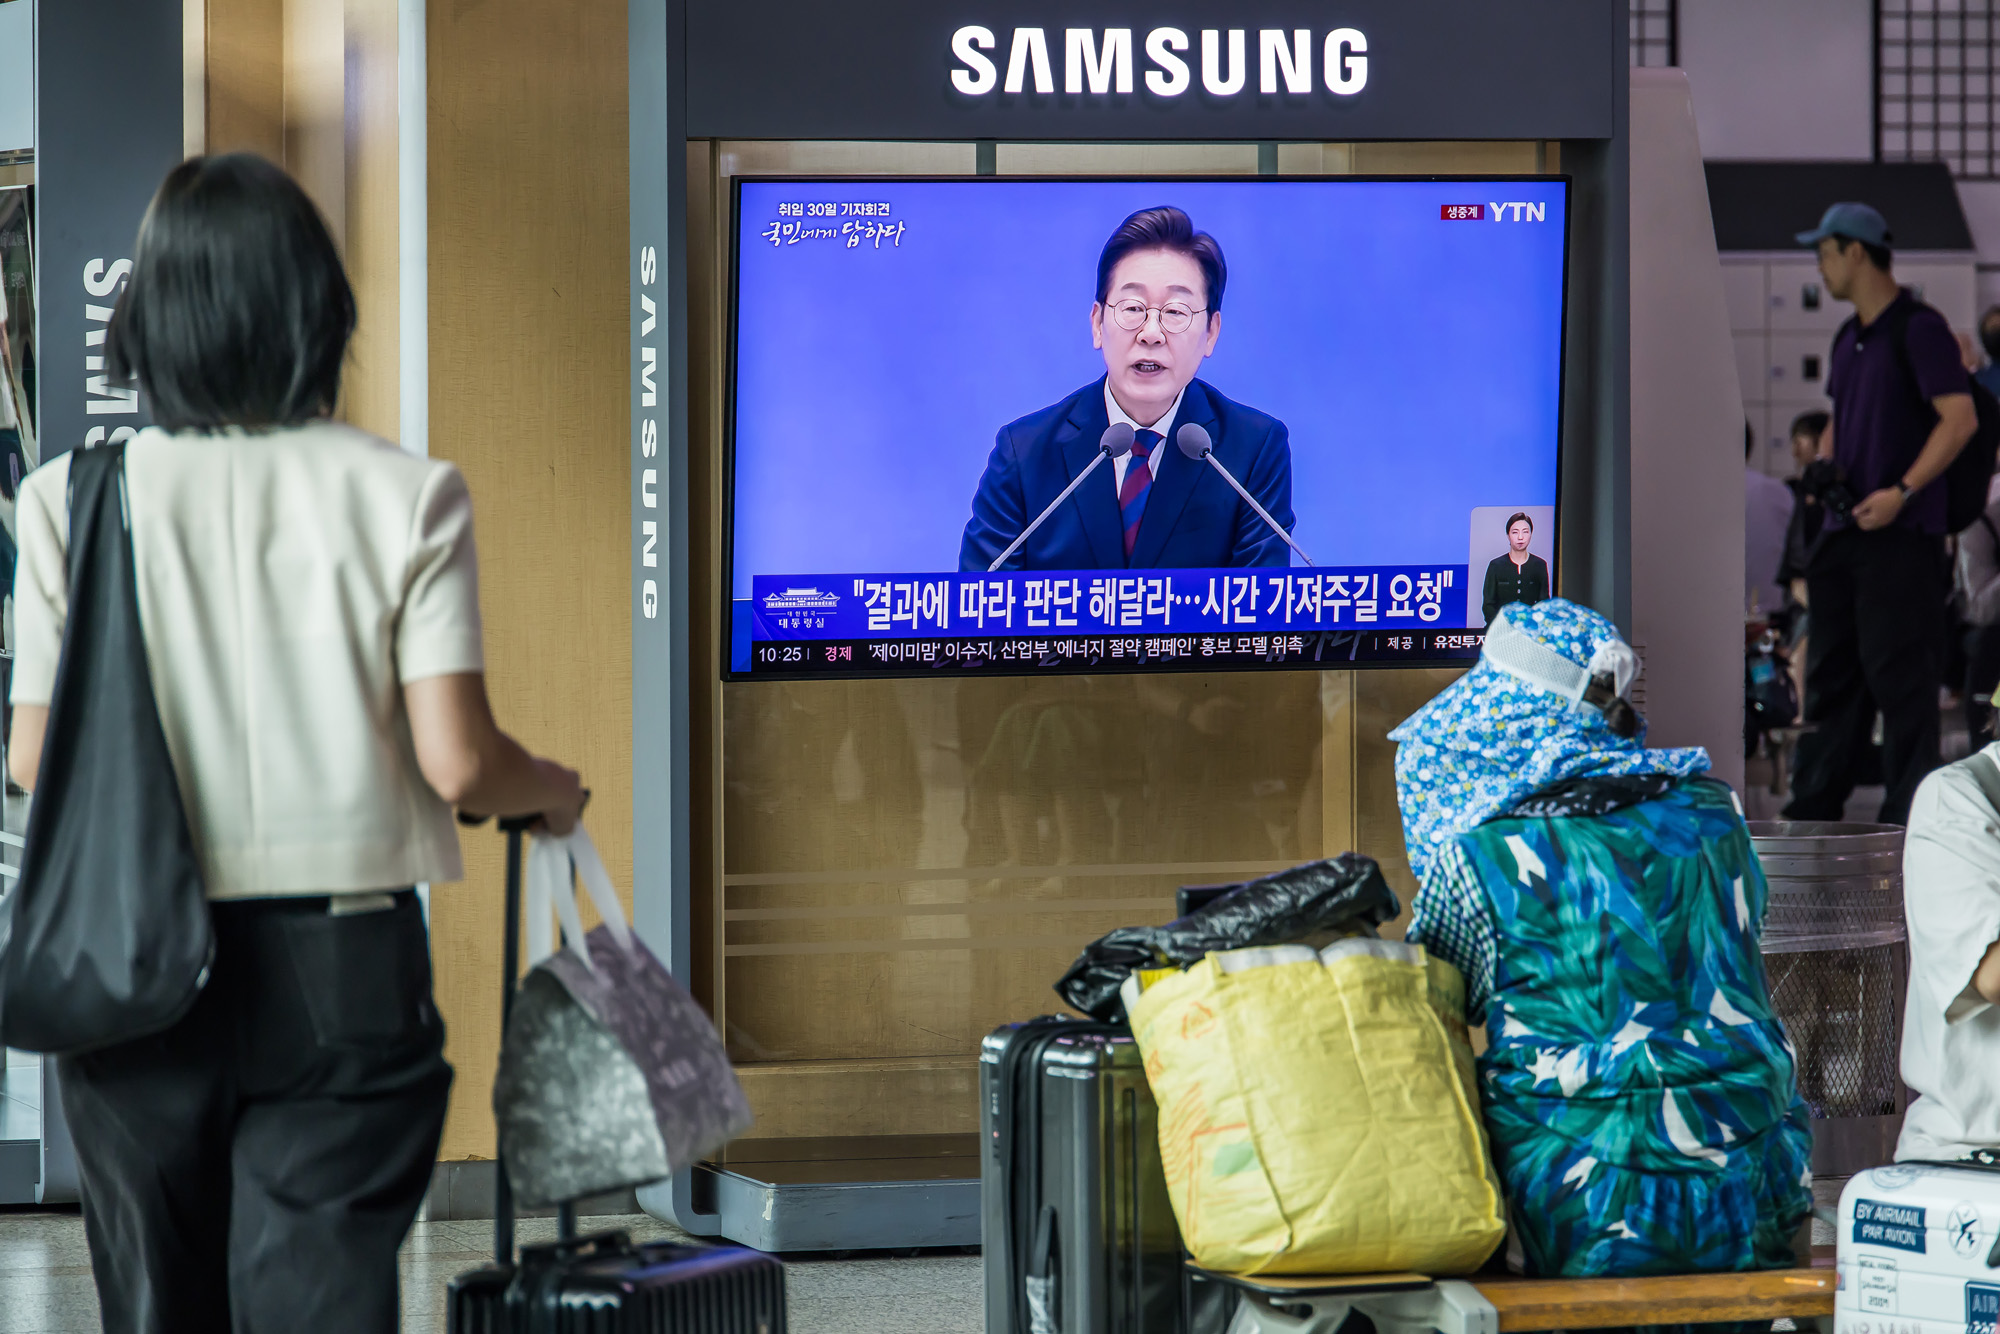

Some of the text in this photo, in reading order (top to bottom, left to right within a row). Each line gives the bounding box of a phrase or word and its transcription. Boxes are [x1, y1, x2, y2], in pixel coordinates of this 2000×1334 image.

[952, 26, 1368, 96] SAMSUNG
[779, 203, 890, 216] 취임 30일 기자회견
[1447, 206, 1477, 218] 생중계
[1489, 202, 1545, 222] YTN
[762, 219, 906, 249] 국민에게 답하다
[641, 246, 658, 619] SAMSUNG
[853, 579, 950, 631] "결과에
[959, 579, 1016, 629] 따라
[1023, 578, 1081, 627] 판단
[1266, 573, 1378, 624] 가져주길
[1385, 570, 1454, 622] 요청"
[779, 617, 825, 629] 대통령실
[759, 647, 802, 662] 10:25
[825, 646, 852, 662] 경제
[869, 643, 941, 662] '제이미맘'
[945, 642, 997, 661] 이수지,
[1000, 640, 1050, 659] 산업부
[1053, 639, 1104, 658] '에너지
[1109, 638, 1141, 658] 절약
[1145, 638, 1197, 657] 캠페인'
[1200, 637, 1232, 656] 홍보
[1235, 636, 1267, 655] 모델
[1271, 635, 1304, 655] 위촉
[1387, 636, 1413, 650] 제공
[1856, 1203, 1922, 1227] BY AIRMAIL
[1862, 1223, 1917, 1247] PAR AVION
[1971, 1293, 1999, 1314] AIR
